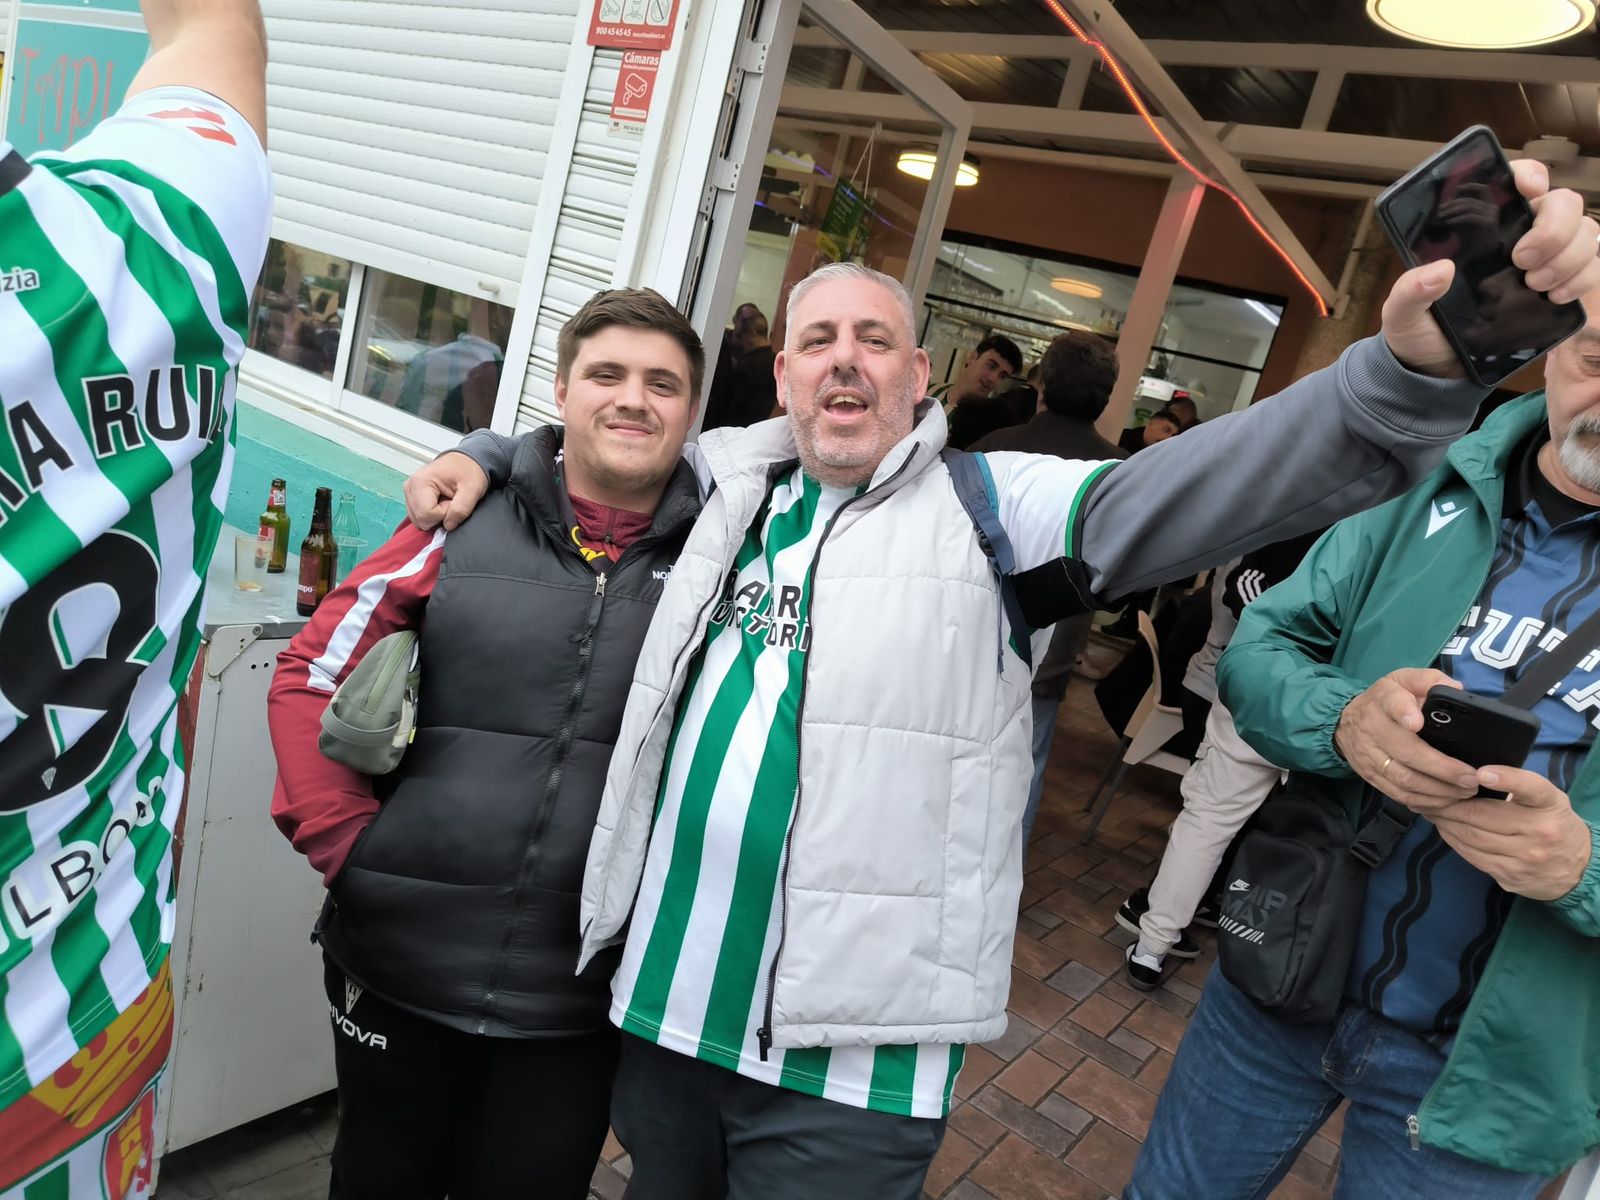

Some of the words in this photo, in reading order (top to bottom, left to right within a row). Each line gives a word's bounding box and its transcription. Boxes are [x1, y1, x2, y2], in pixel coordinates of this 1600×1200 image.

[624, 52, 660, 66] Cámaras
[0, 268, 39, 292] zia
[82, 364, 227, 459] RUI
